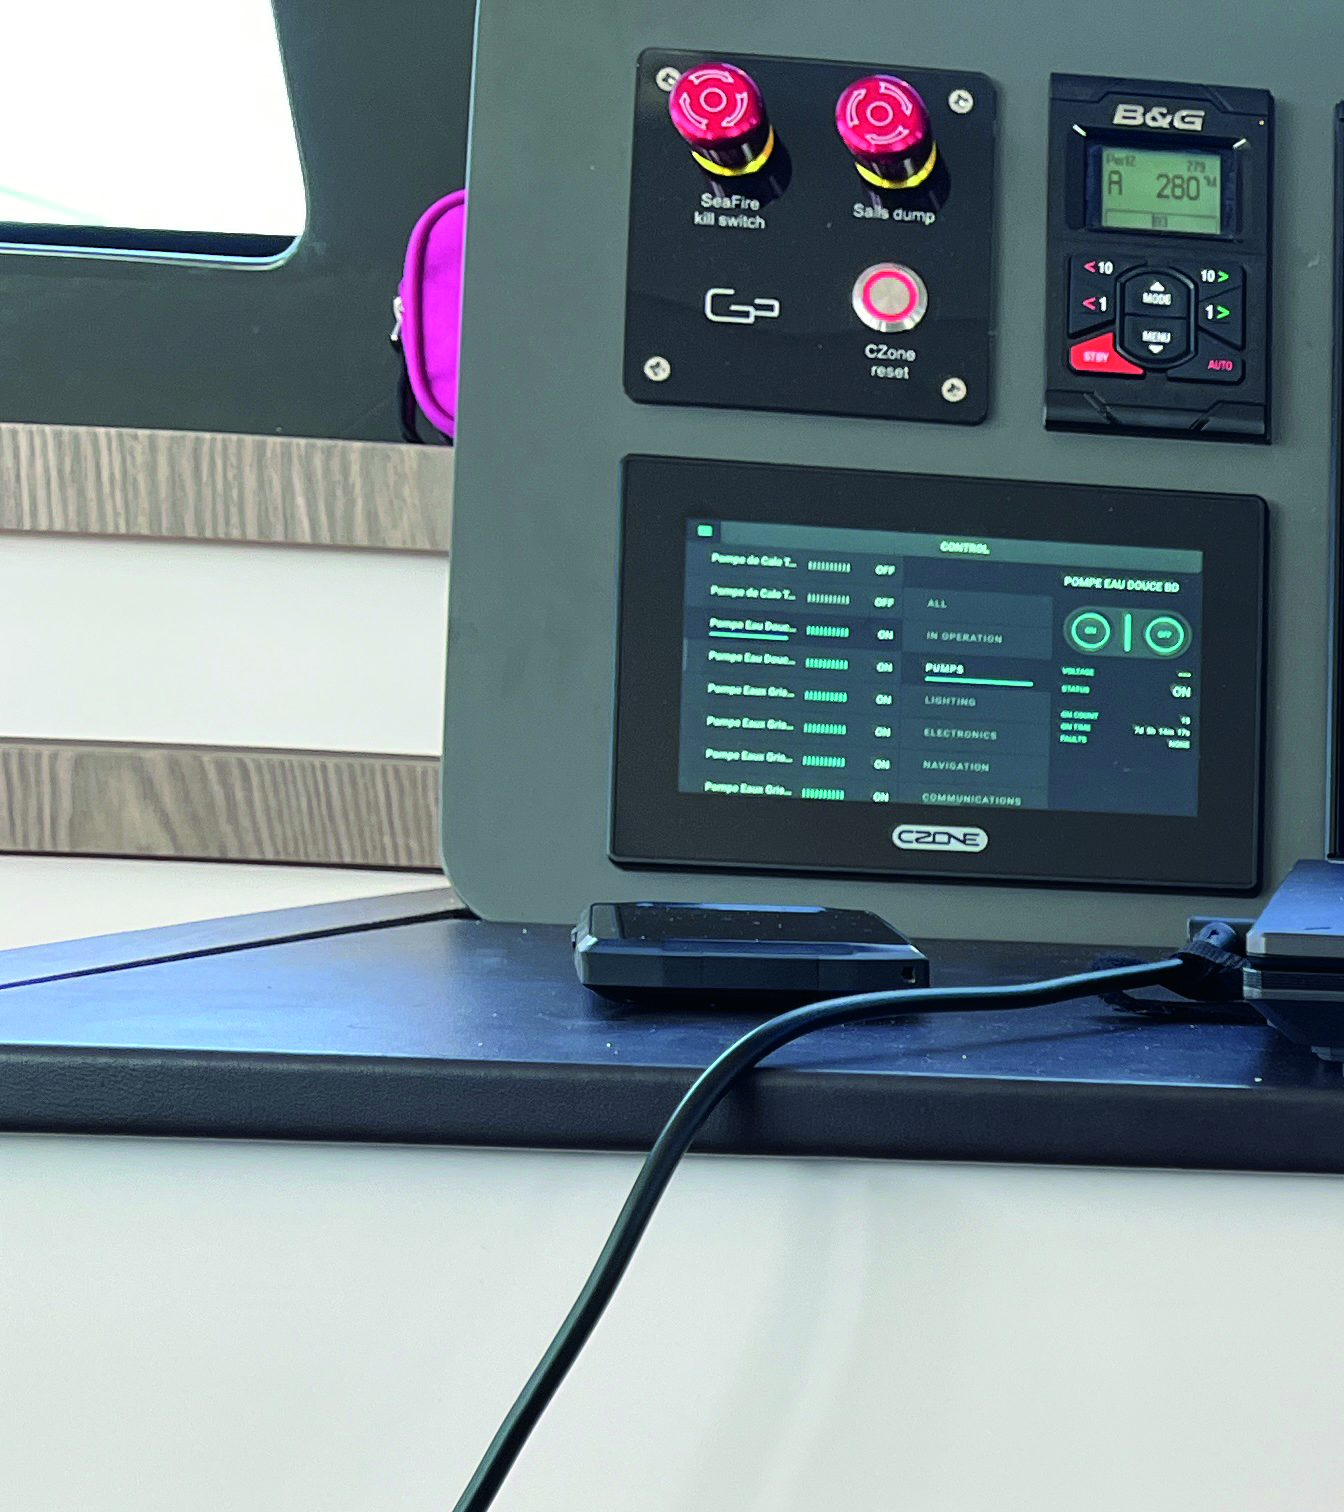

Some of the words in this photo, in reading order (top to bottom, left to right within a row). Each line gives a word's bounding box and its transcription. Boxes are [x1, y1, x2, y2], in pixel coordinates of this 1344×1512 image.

[1113, 104, 1205, 131] B&G
[1107, 170, 1123, 196] A
[1156, 173, 1200, 201] 280
[700, 192, 761, 211] SeaFire
[694, 210, 715, 227] kill
[718, 213, 766, 229] switch
[852, 203, 889, 220] Sails
[892, 207, 936, 225] dump
[864, 343, 917, 362] CZone
[1207, 359, 1233, 371] AUTO
[870, 365, 910, 380] reset
[940, 540, 990, 555] CONTROL
[927, 598, 947, 609] ALL
[877, 629, 894, 640] ON
[941, 631, 1003, 643] OPERATION
[876, 661, 893, 673] ON
[925, 662, 964, 675] PUMPS
[1172, 685, 1192, 698] ON
[875, 694, 892, 705] ON
[924, 695, 976, 707] LIGHTING
[874, 726, 891, 738] ON
[923, 728, 997, 741] ELECTRONICS
[873, 759, 890, 770] ON
[922, 760, 990, 772] NAVIGATION
[922, 792, 1022, 806] COMMUNICATIONS
[898, 829, 980, 847] CZONE
